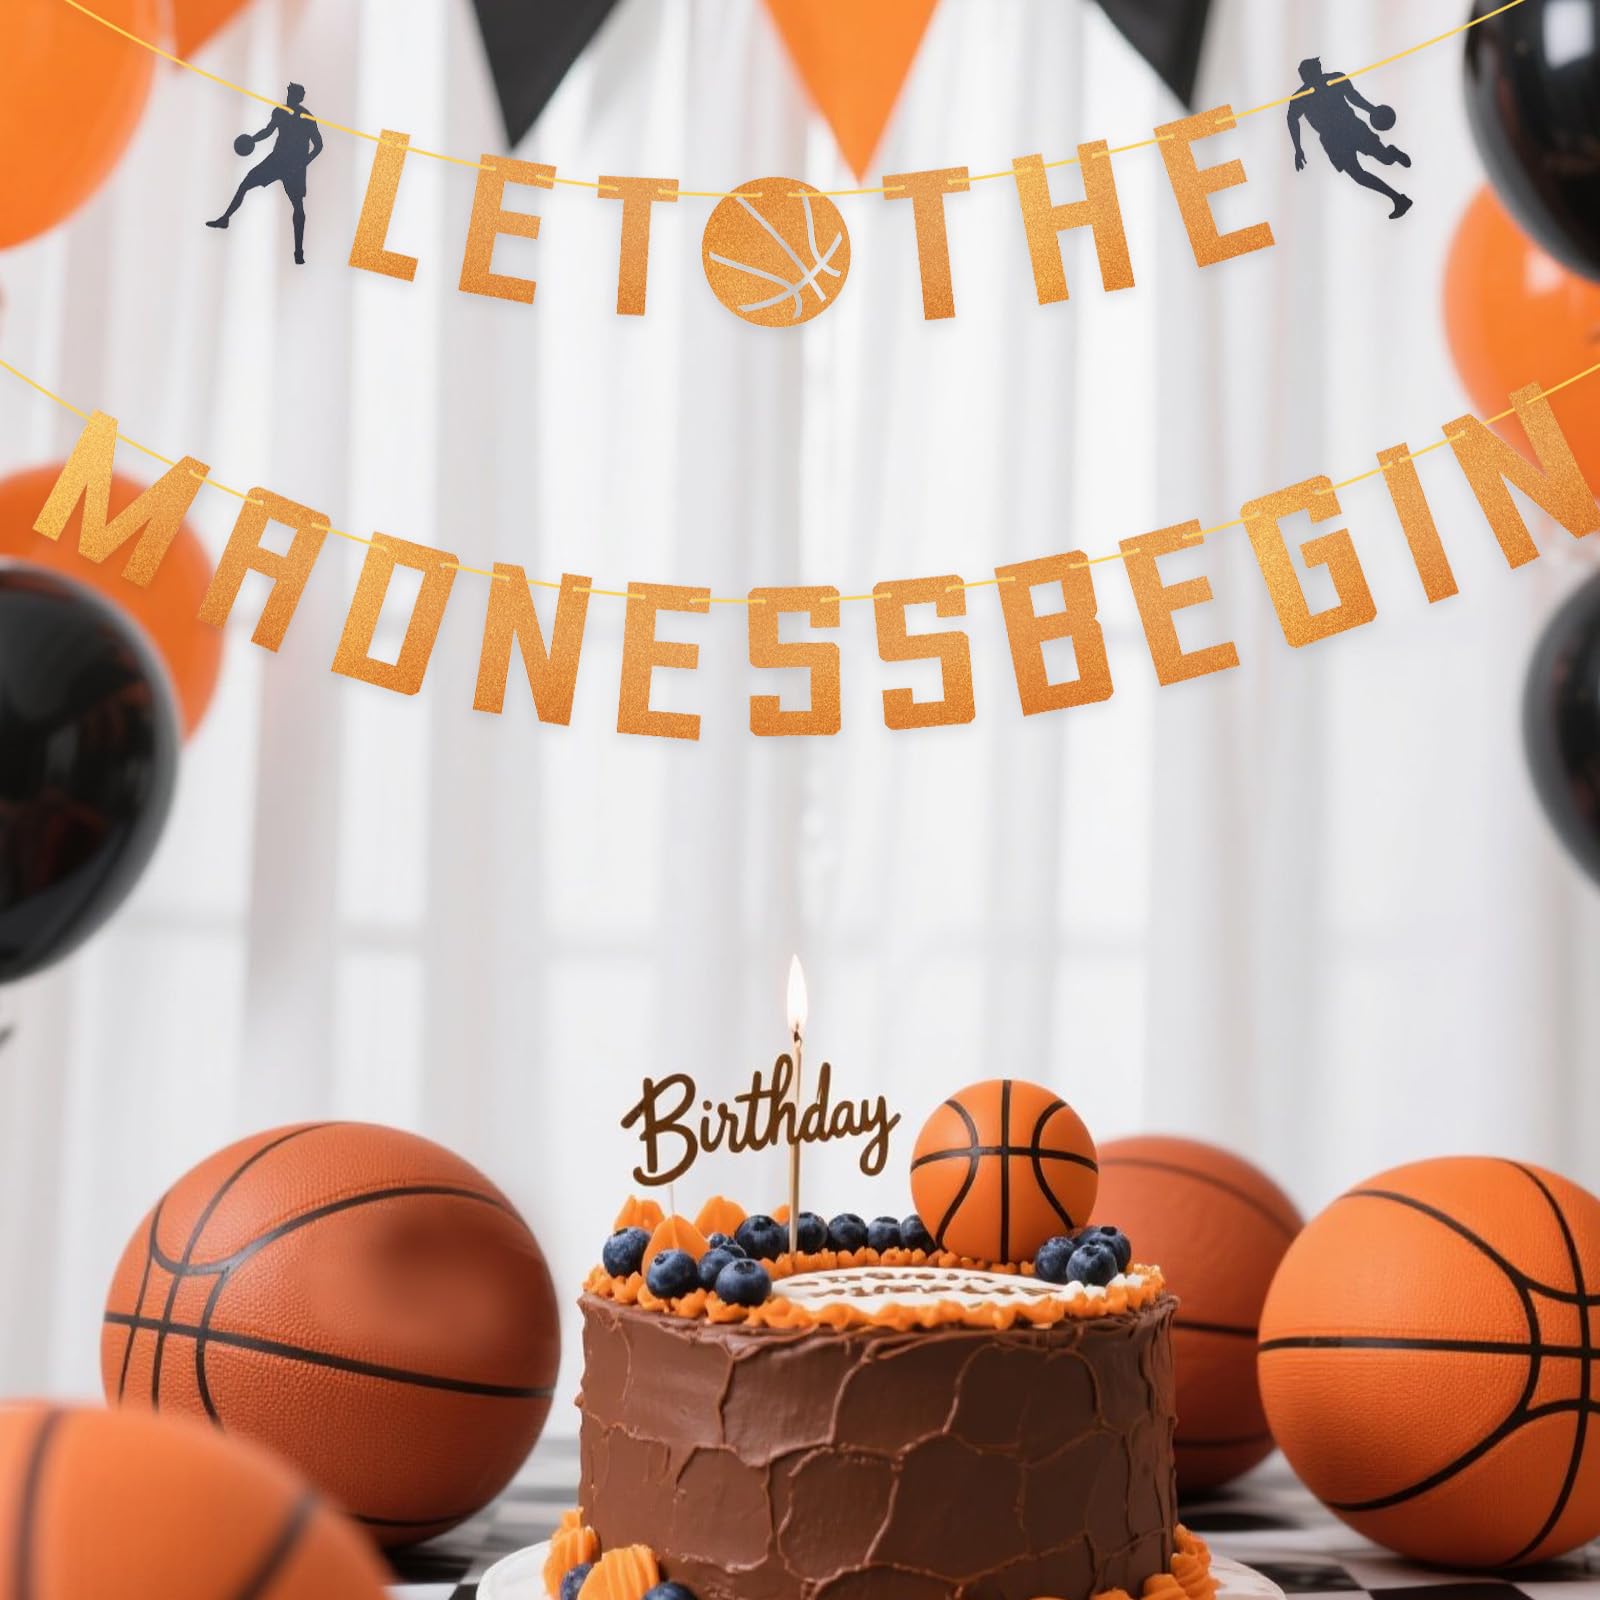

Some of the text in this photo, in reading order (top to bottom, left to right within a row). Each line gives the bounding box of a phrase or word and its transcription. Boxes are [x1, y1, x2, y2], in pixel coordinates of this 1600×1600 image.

[348, 104, 1276, 321] LET THE
[620, 1053, 901, 1187] Birthday
